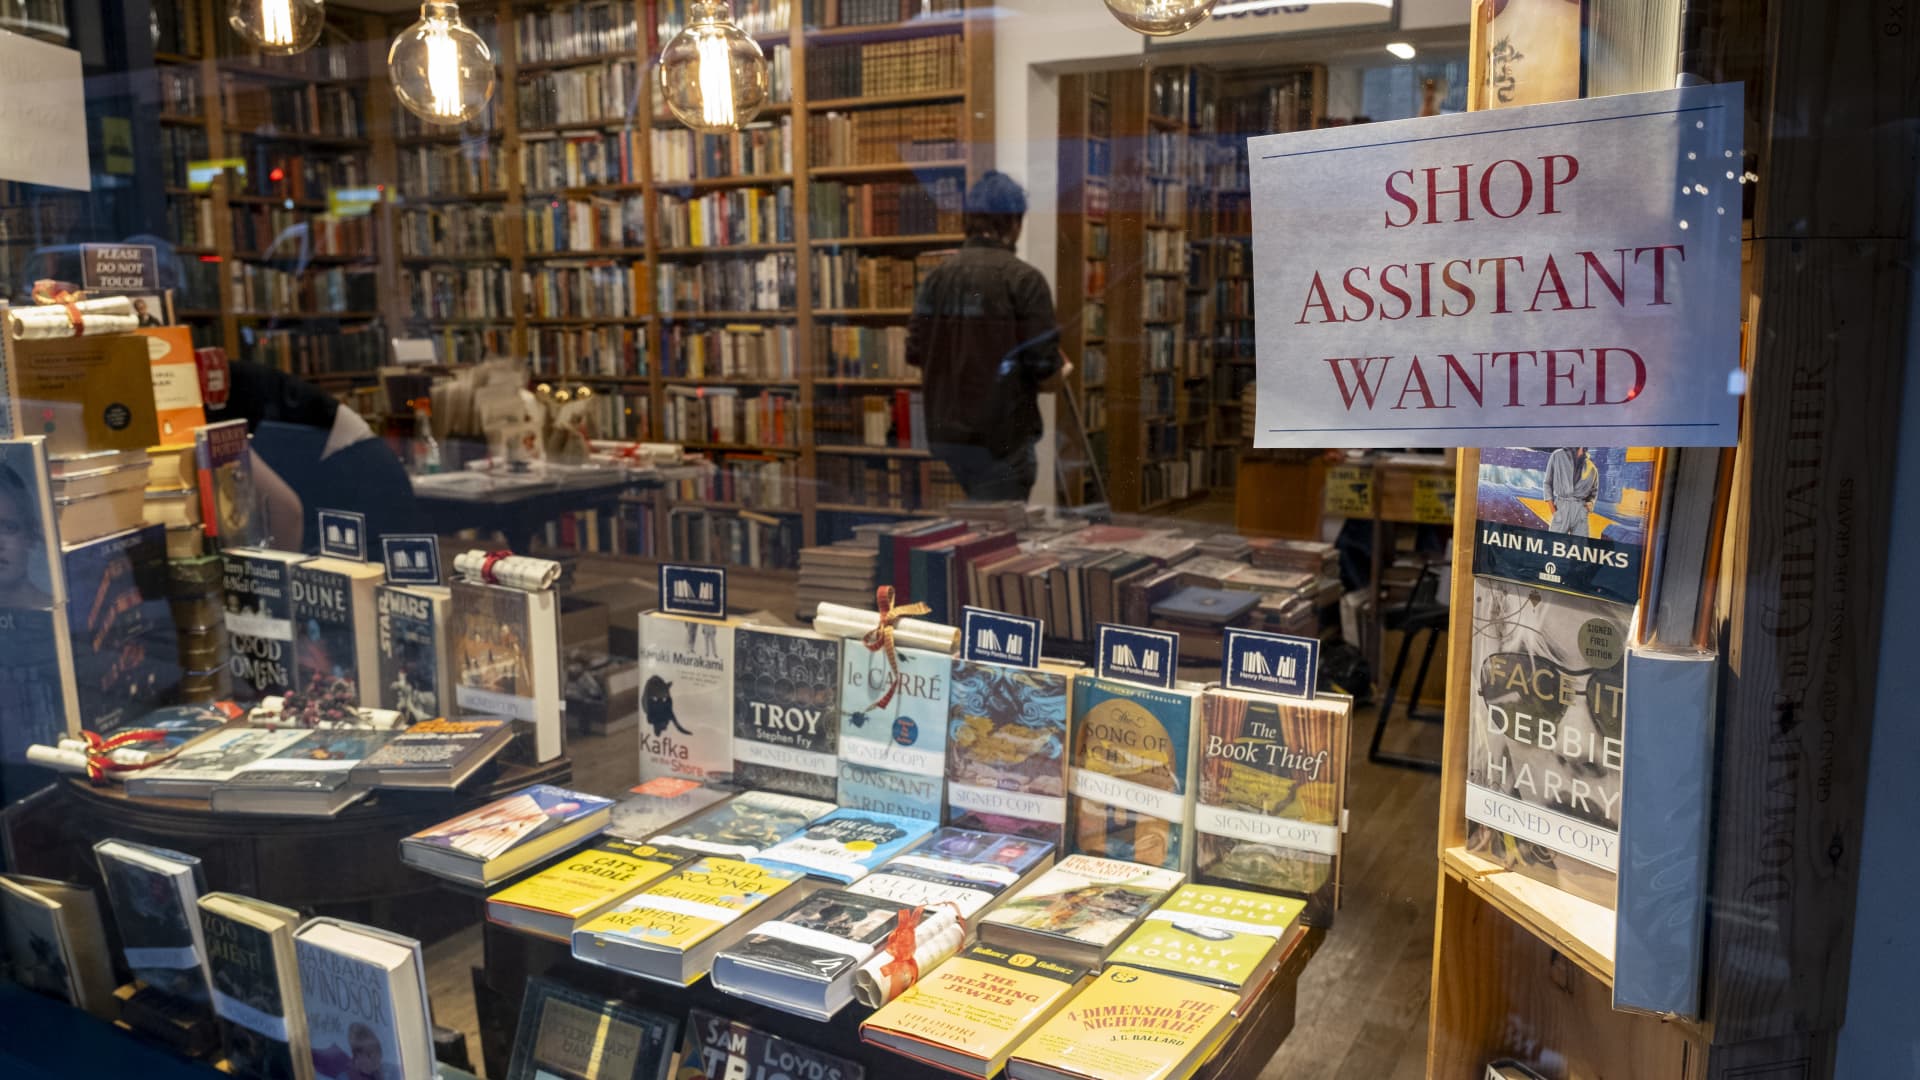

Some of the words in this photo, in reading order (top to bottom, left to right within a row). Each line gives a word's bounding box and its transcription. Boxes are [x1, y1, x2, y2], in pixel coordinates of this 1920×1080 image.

[1384, 154, 1579, 229] SHOP
[97, 248, 140, 260] PLEASE
[96, 262, 114, 274] DO
[117, 263, 144, 275] NOT
[100, 275, 144, 288] TOUCH
[1294, 244, 1685, 324] ASSISTANT
[1323, 347, 1647, 411] WANTED
[1482, 528, 1522, 554] IAIN
[1525, 534, 1549, 557] M.
[1552, 541, 1629, 570] BANKS
[250, 579, 281, 598] Gaiman
[291, 580, 346, 611] DUNE
[387, 591, 430, 620] WARS
[379, 590, 393, 658] STAR
[1587, 623, 1613, 636] SIGNED
[1590, 636, 1609, 648] FIRST
[1816, 729, 1836, 803] GRAND
[1836, 477, 1855, 560] GRAVES
[672, 652, 724, 672] Murakami
[975, 647, 990, 657] Henry
[1008, 653, 1023, 662] Books
[1585, 647, 1613, 660] EDITION
[848, 661, 863, 687] le
[868, 667, 942, 701] CARRÉ
[1110, 664, 1126, 675] Henry
[1144, 669, 1160, 678] Books
[1239, 671, 1258, 682] Henry
[1258, 674, 1278, 684] Pordes
[1279, 676, 1297, 686] Books
[1488, 656, 1578, 707] FACE
[1594, 682, 1624, 719] IT
[750, 701, 821, 735] TROY
[1250, 720, 1277, 739] The
[640, 732, 689, 760] Kafka
[756, 727, 794, 744] Stephen
[796, 734, 812, 749] Fry
[1086, 722, 1137, 748] SONG
[1143, 735, 1169, 753] OF
[1487, 703, 1621, 771] DEBBIE
[671, 758, 704, 776] Shore
[798, 754, 825, 769] COPY
[847, 742, 889, 760] SIGNED
[892, 751, 928, 769] COPY
[1208, 735, 1260, 763] Book
[1265, 744, 1328, 781] Thief
[840, 763, 935, 799] CONSTANT
[1074, 774, 1122, 797] SIGNED
[1125, 788, 1163, 809] COPY
[1486, 751, 1620, 820] HARRY
[956, 790, 1004, 809] SIGNED
[1006, 799, 1044, 814] COPY
[1214, 815, 1271, 835] SIGNED
[1276, 825, 1321, 844] COPY
[1484, 797, 1551, 837] SIGNED
[1557, 824, 1614, 859] COPY
[568, 863, 638, 882] CRADLE
[593, 857, 642, 873] CAT'S
[714, 864, 769, 880] SALLY
[676, 872, 772, 894] ROONEY
[867, 878, 973, 901] OLIVER
[648, 888, 738, 910] BEAUTIFUL
[1178, 900, 1276, 921] PEOPLE
[1180, 890, 1287, 914] NORMAL
[607, 914, 643, 927] ARE
[648, 920, 691, 936] YOU
[631, 905, 696, 922] WHERE
[203, 913, 238, 939] ZOO
[1125, 945, 1241, 971] ROONEY
[1151, 937, 1233, 957] SALLY
[300, 948, 382, 991] BARBARA
[1013, 955, 1029, 966] SF
[1036, 960, 1074, 975] Gollancz
[939, 973, 1040, 1003] DREAMING
[980, 971, 1018, 987] THE
[302, 969, 389, 1027] WINDSOR
[943, 983, 1014, 1007] JEWELS
[1178, 998, 1219, 1015] THE
[904, 1012, 977, 1038] THEODORE
[1083, 1014, 1201, 1035] NIGHTMARE
[705, 1018, 748, 1056] SAM
[763, 1038, 843, 1080] LOYD'S
[1132, 1034, 1186, 1047] BALLARD
